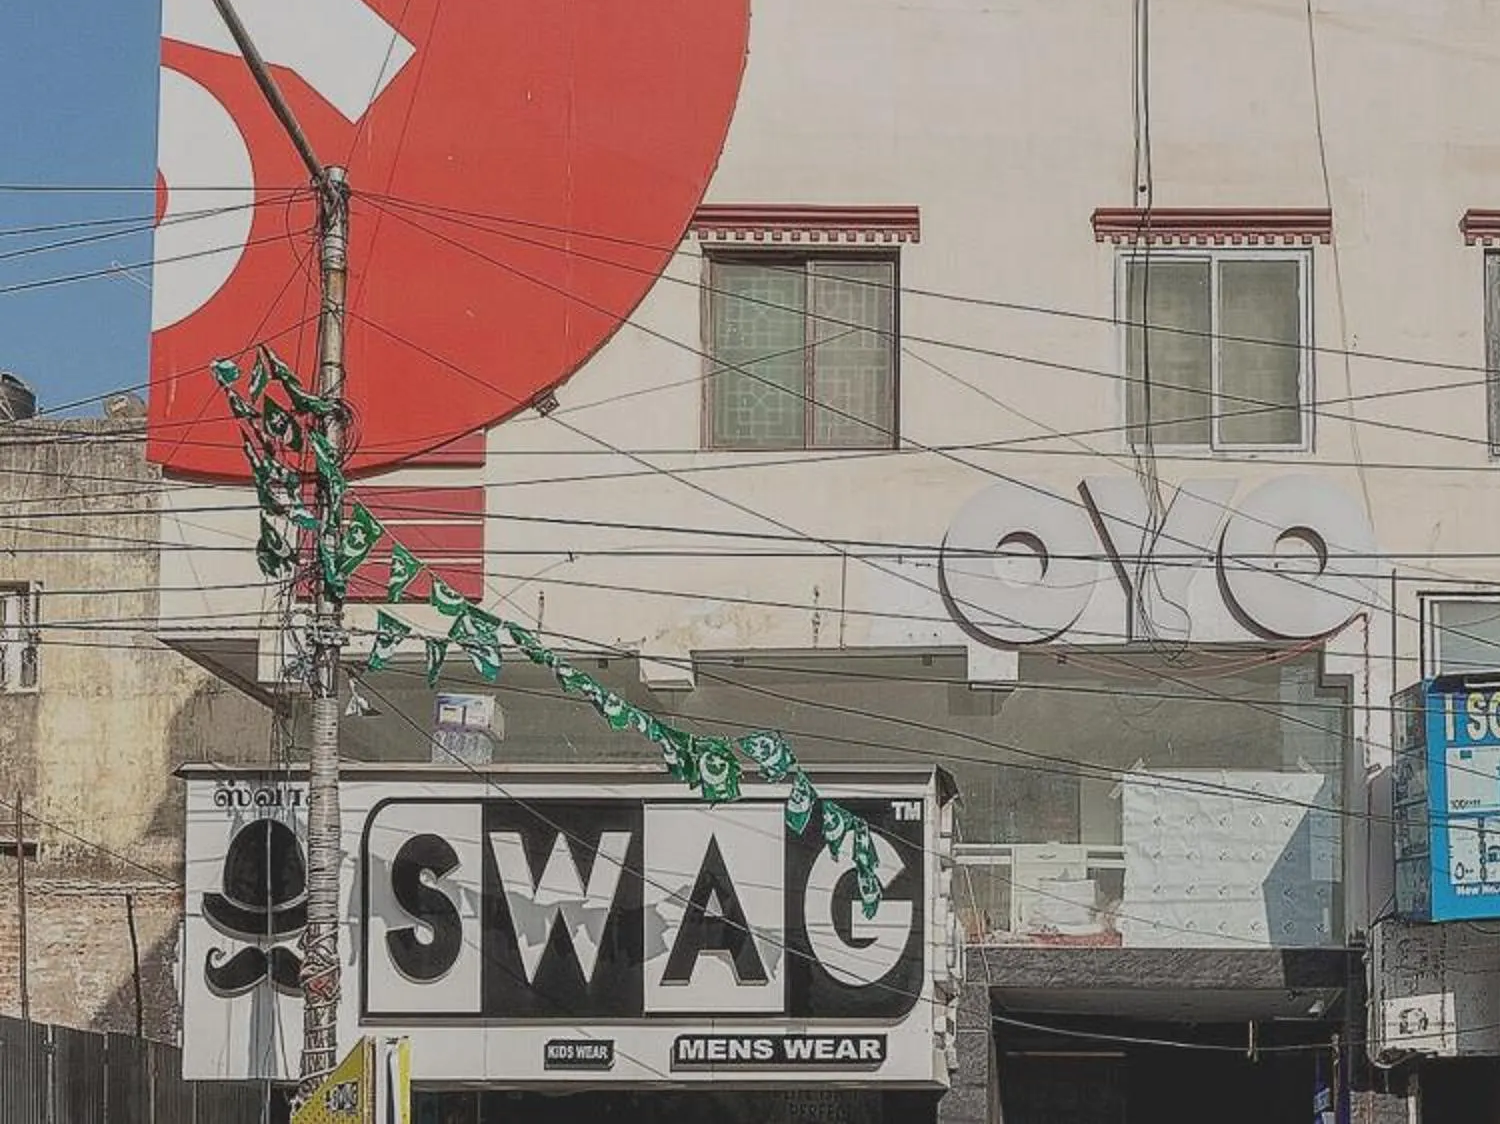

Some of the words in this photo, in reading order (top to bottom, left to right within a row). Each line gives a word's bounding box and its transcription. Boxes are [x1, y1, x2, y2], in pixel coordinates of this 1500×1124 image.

[891, 801, 921, 821] TM
[385, 831, 914, 988] SWAG
[547, 1044, 575, 1059] KIDS
[576, 1044, 609, 1060] WEAR
[678, 1039, 773, 1061] MENS
[784, 1038, 881, 1060] WEAR
